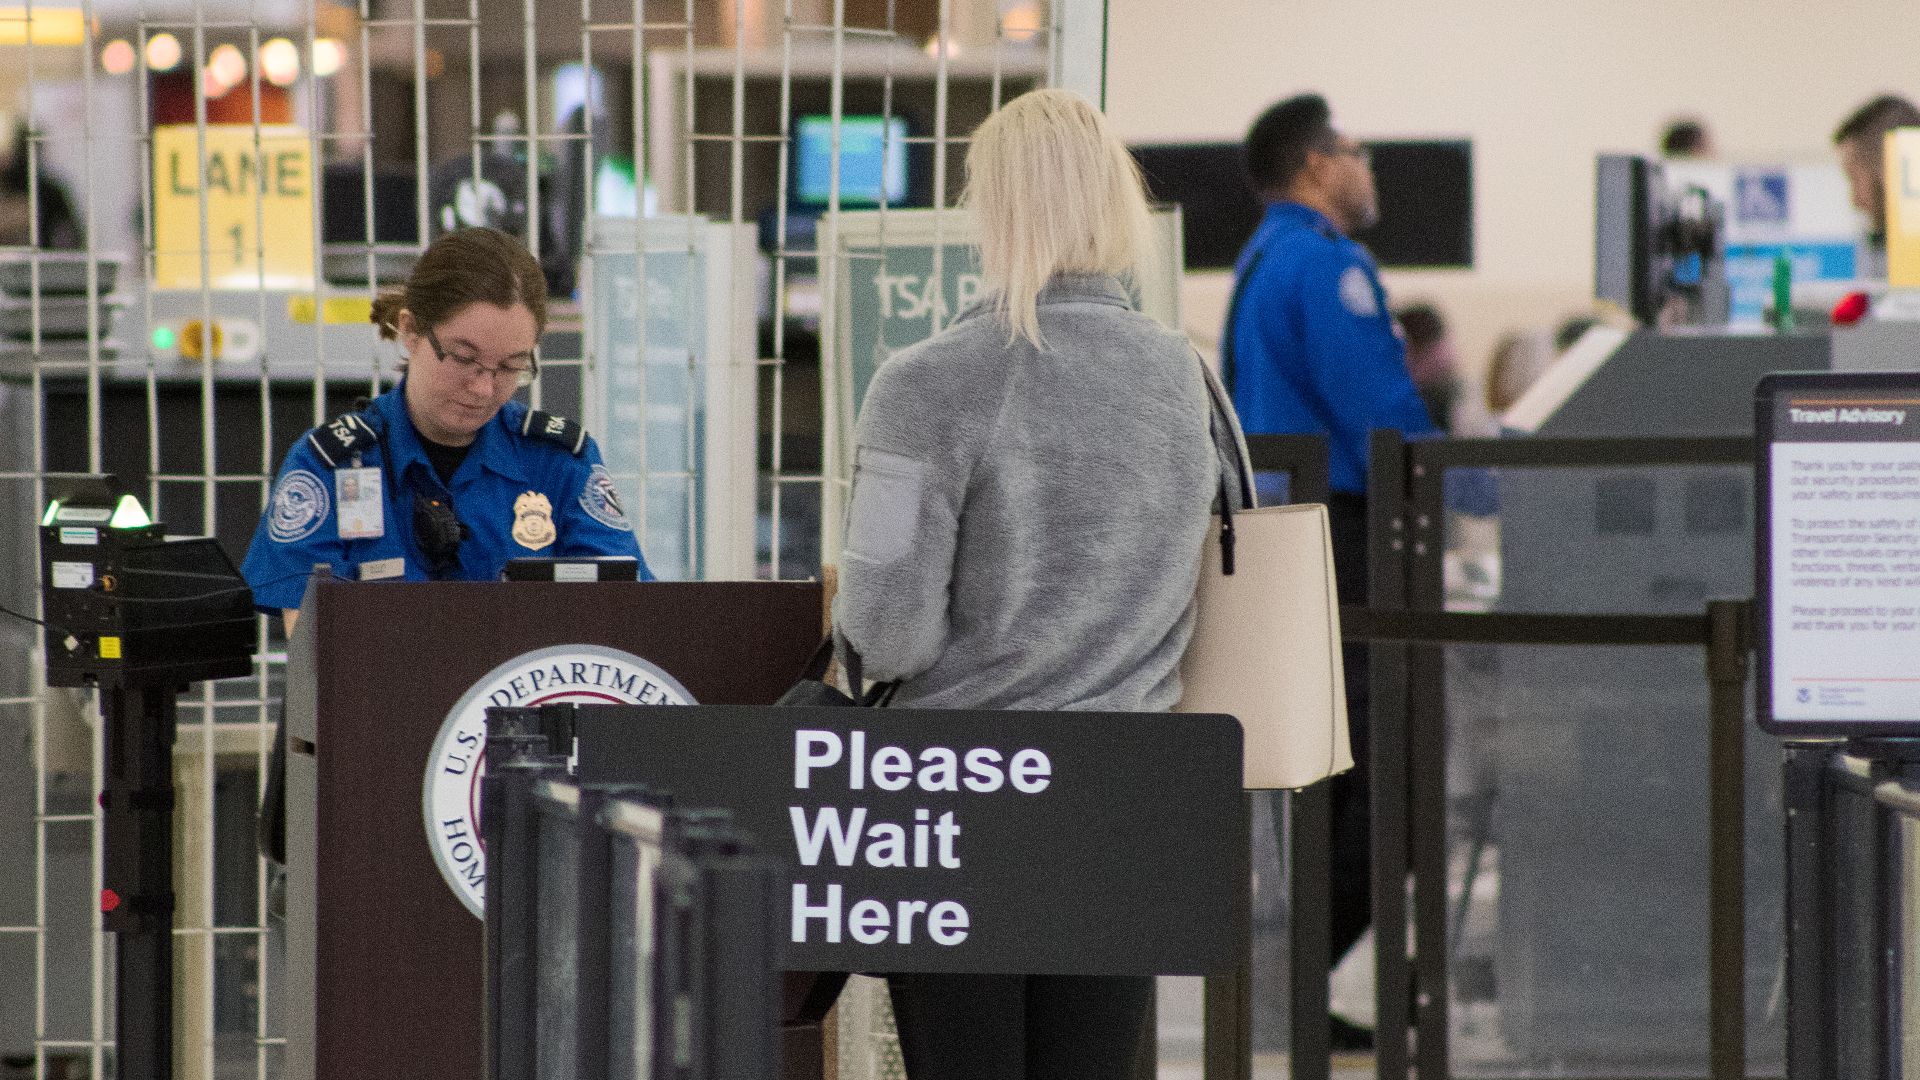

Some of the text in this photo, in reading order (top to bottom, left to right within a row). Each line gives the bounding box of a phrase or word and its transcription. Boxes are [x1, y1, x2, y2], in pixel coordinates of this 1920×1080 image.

[169, 151, 304, 197] LANE
[228, 224, 243, 266] 1
[872, 275, 949, 319] TSA
[328, 417, 356, 447] TSA
[545, 415, 566, 434] TSA
[1789, 408, 1906, 426] Travel Advisory
[444, 730, 482, 776] U.S.
[795, 730, 1052, 794] Please
[443, 814, 485, 889] HOM
[789, 806, 961, 869] Wait
[791, 883, 970, 946] Here
